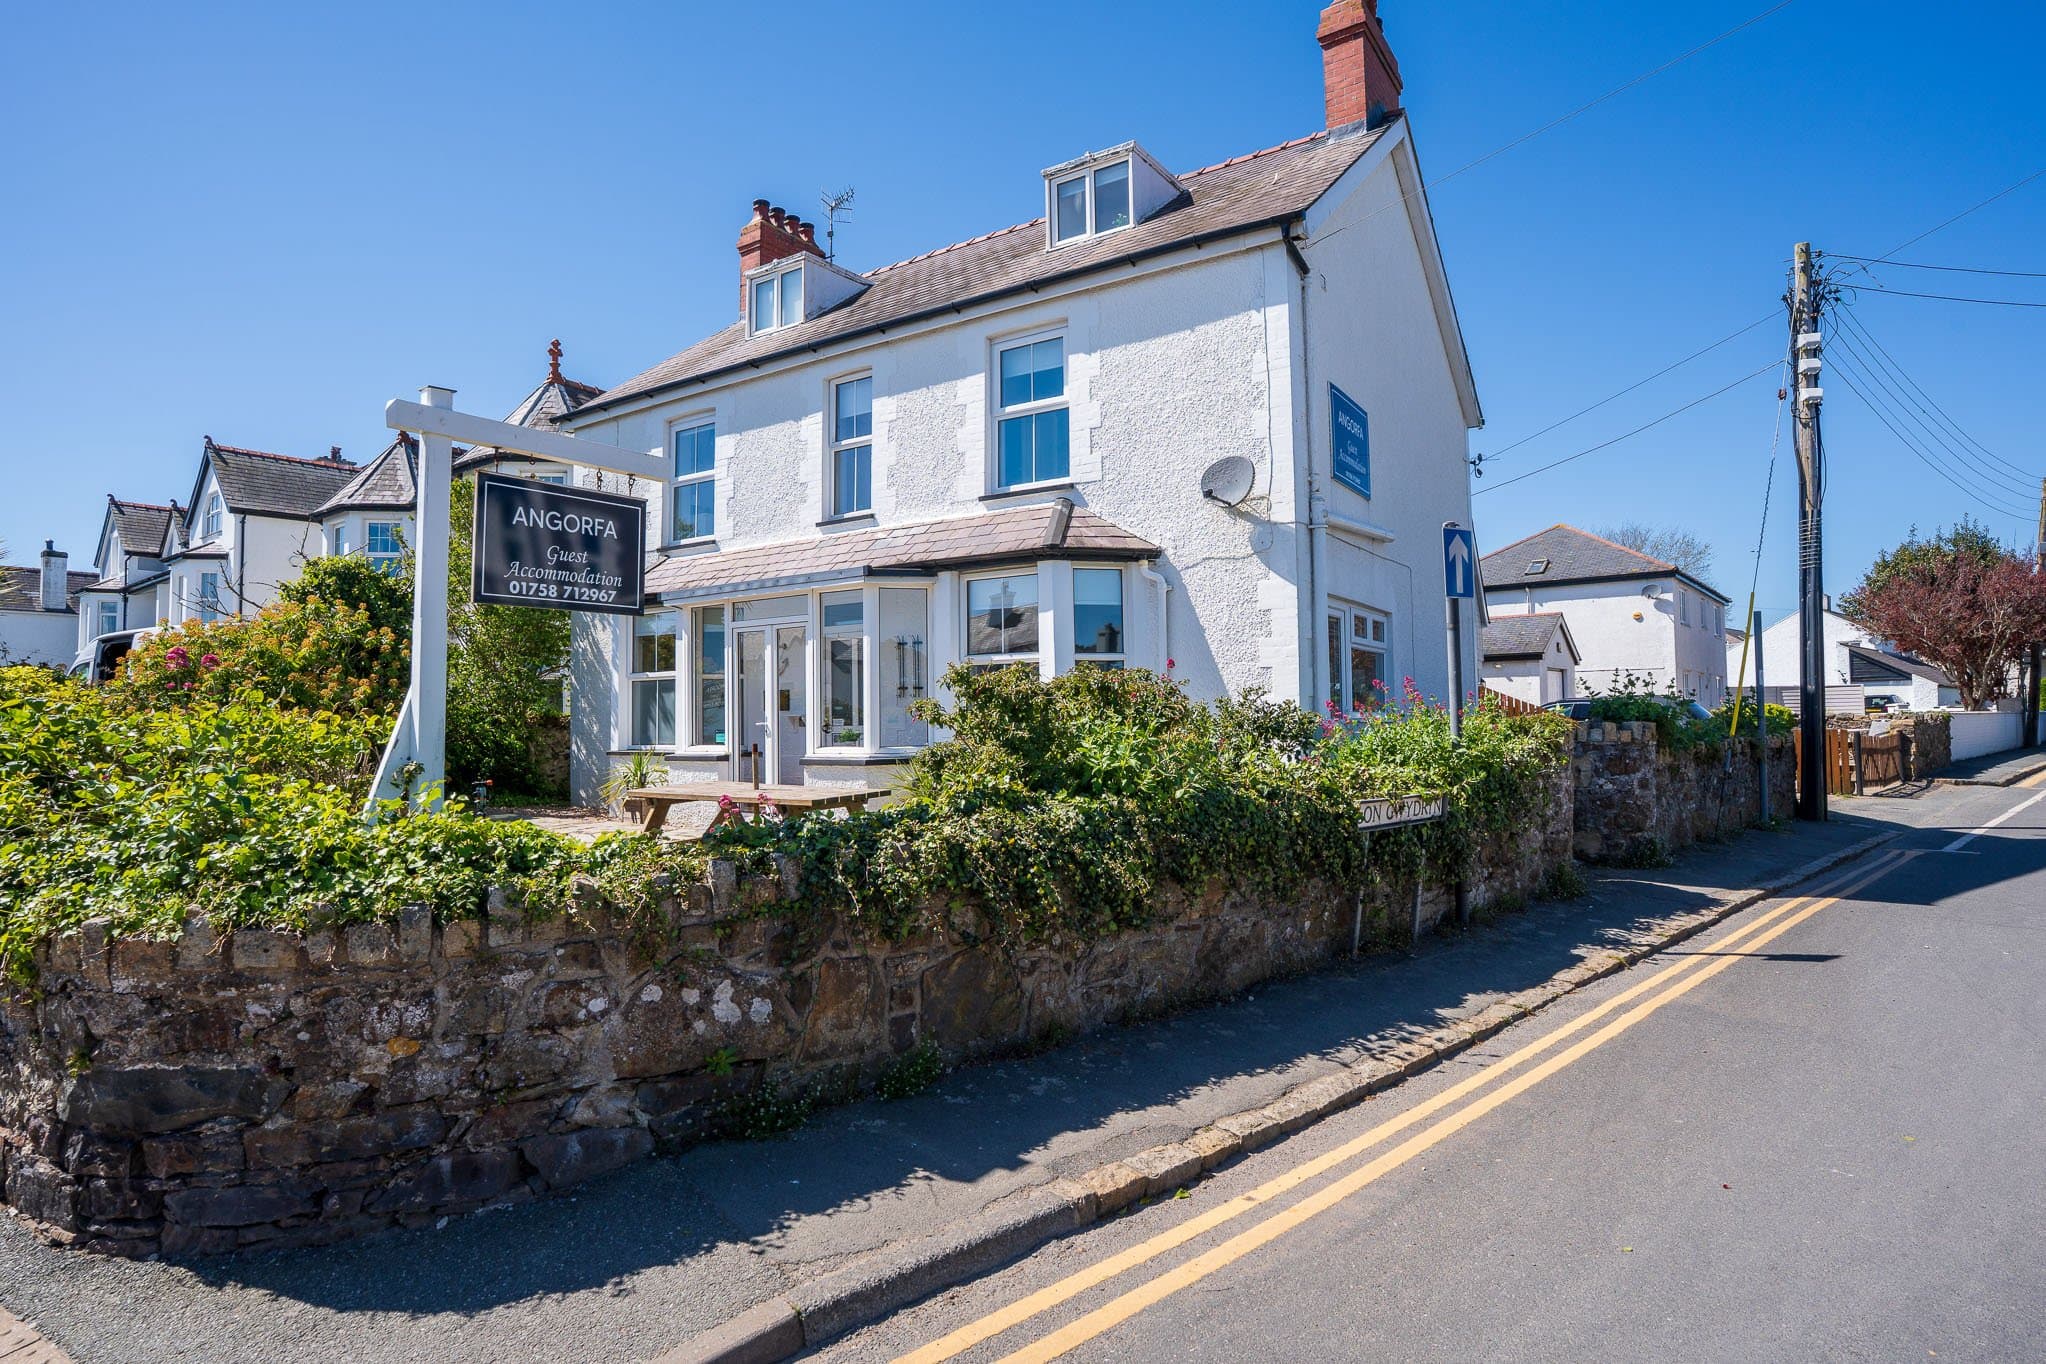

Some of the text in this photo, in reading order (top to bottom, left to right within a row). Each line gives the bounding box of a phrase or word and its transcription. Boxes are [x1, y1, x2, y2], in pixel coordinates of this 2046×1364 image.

[512, 506, 618, 540] ANGORFA
[546, 545, 589, 565] Guest
[503, 560, 623, 587] Accommodation
[509, 580, 617, 603] 01758 712967
